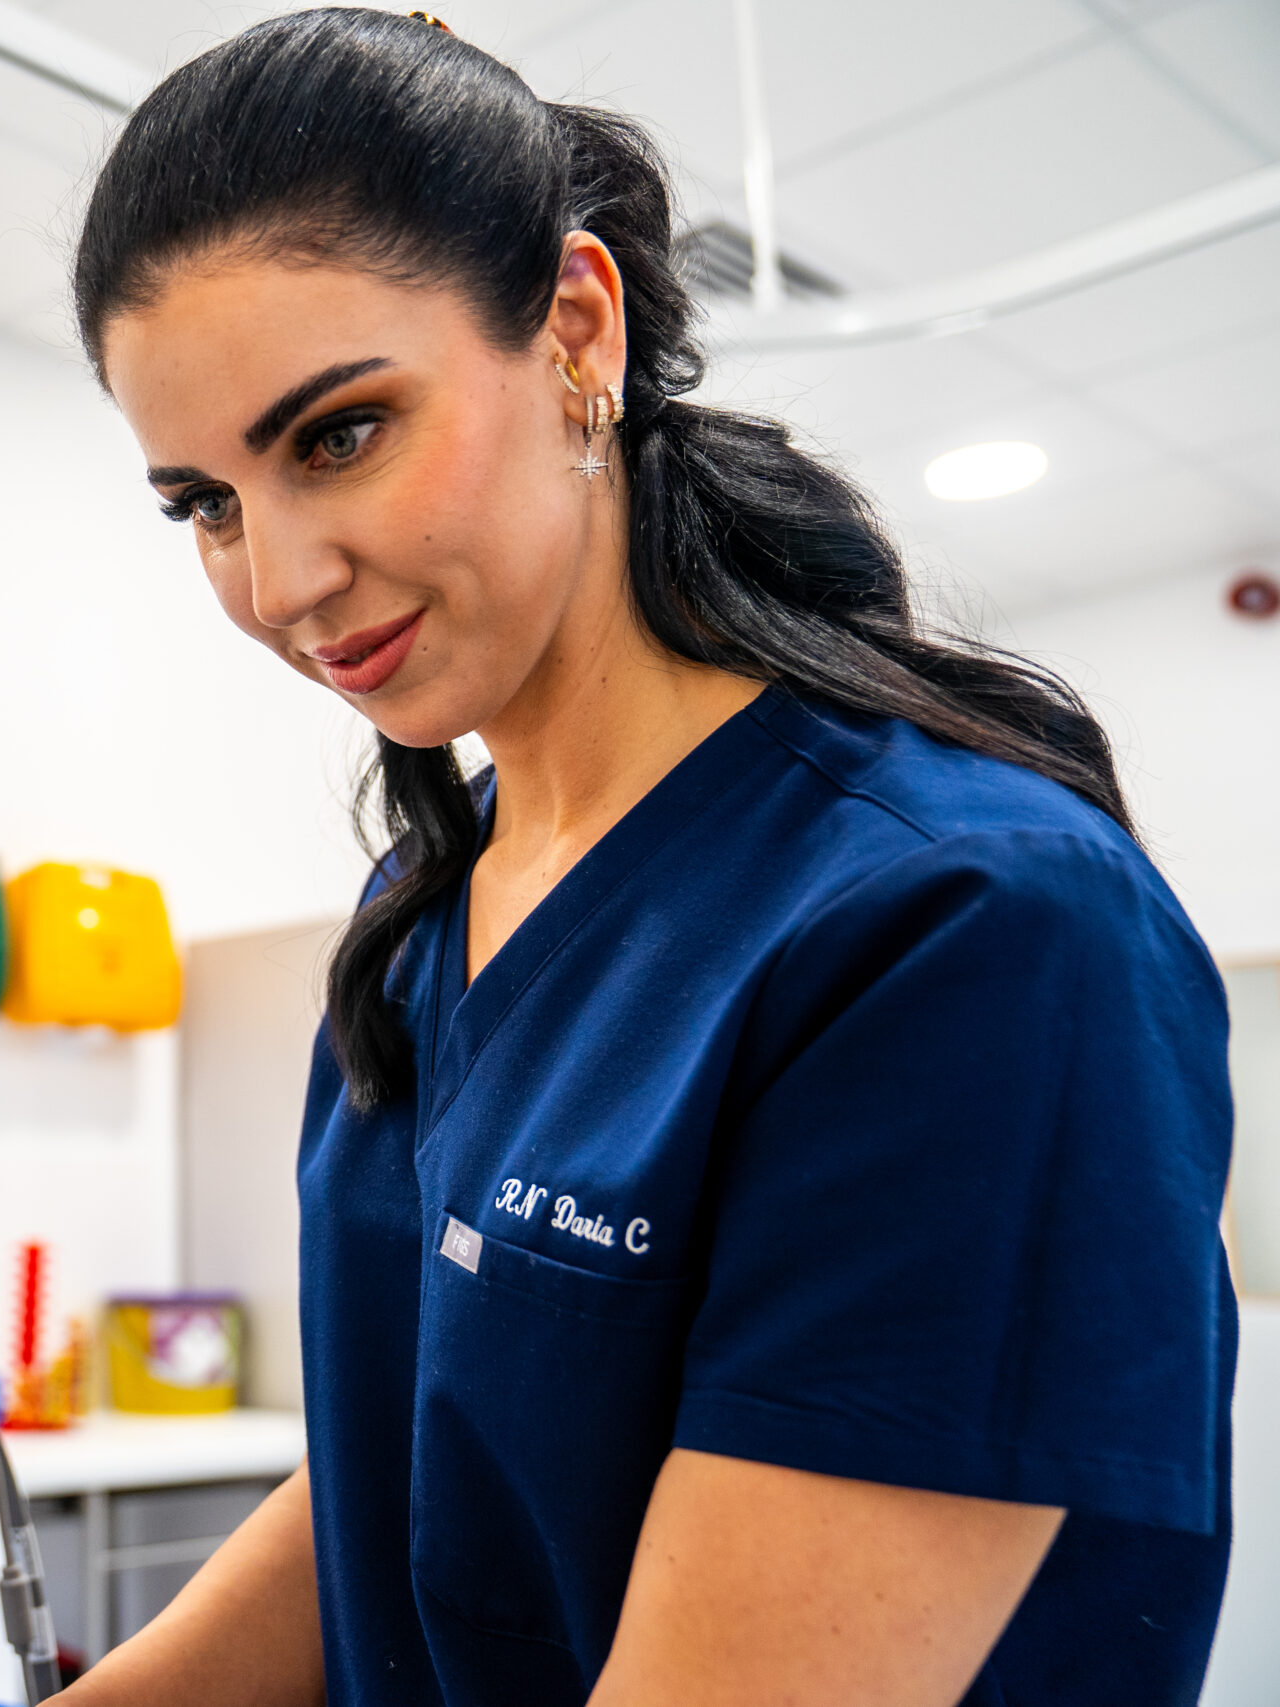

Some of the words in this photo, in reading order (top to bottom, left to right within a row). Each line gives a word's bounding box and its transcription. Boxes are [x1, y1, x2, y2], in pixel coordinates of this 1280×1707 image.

[495, 1178, 548, 1220] RN
[551, 1195, 616, 1248] Daria
[625, 1217, 651, 1254] C
